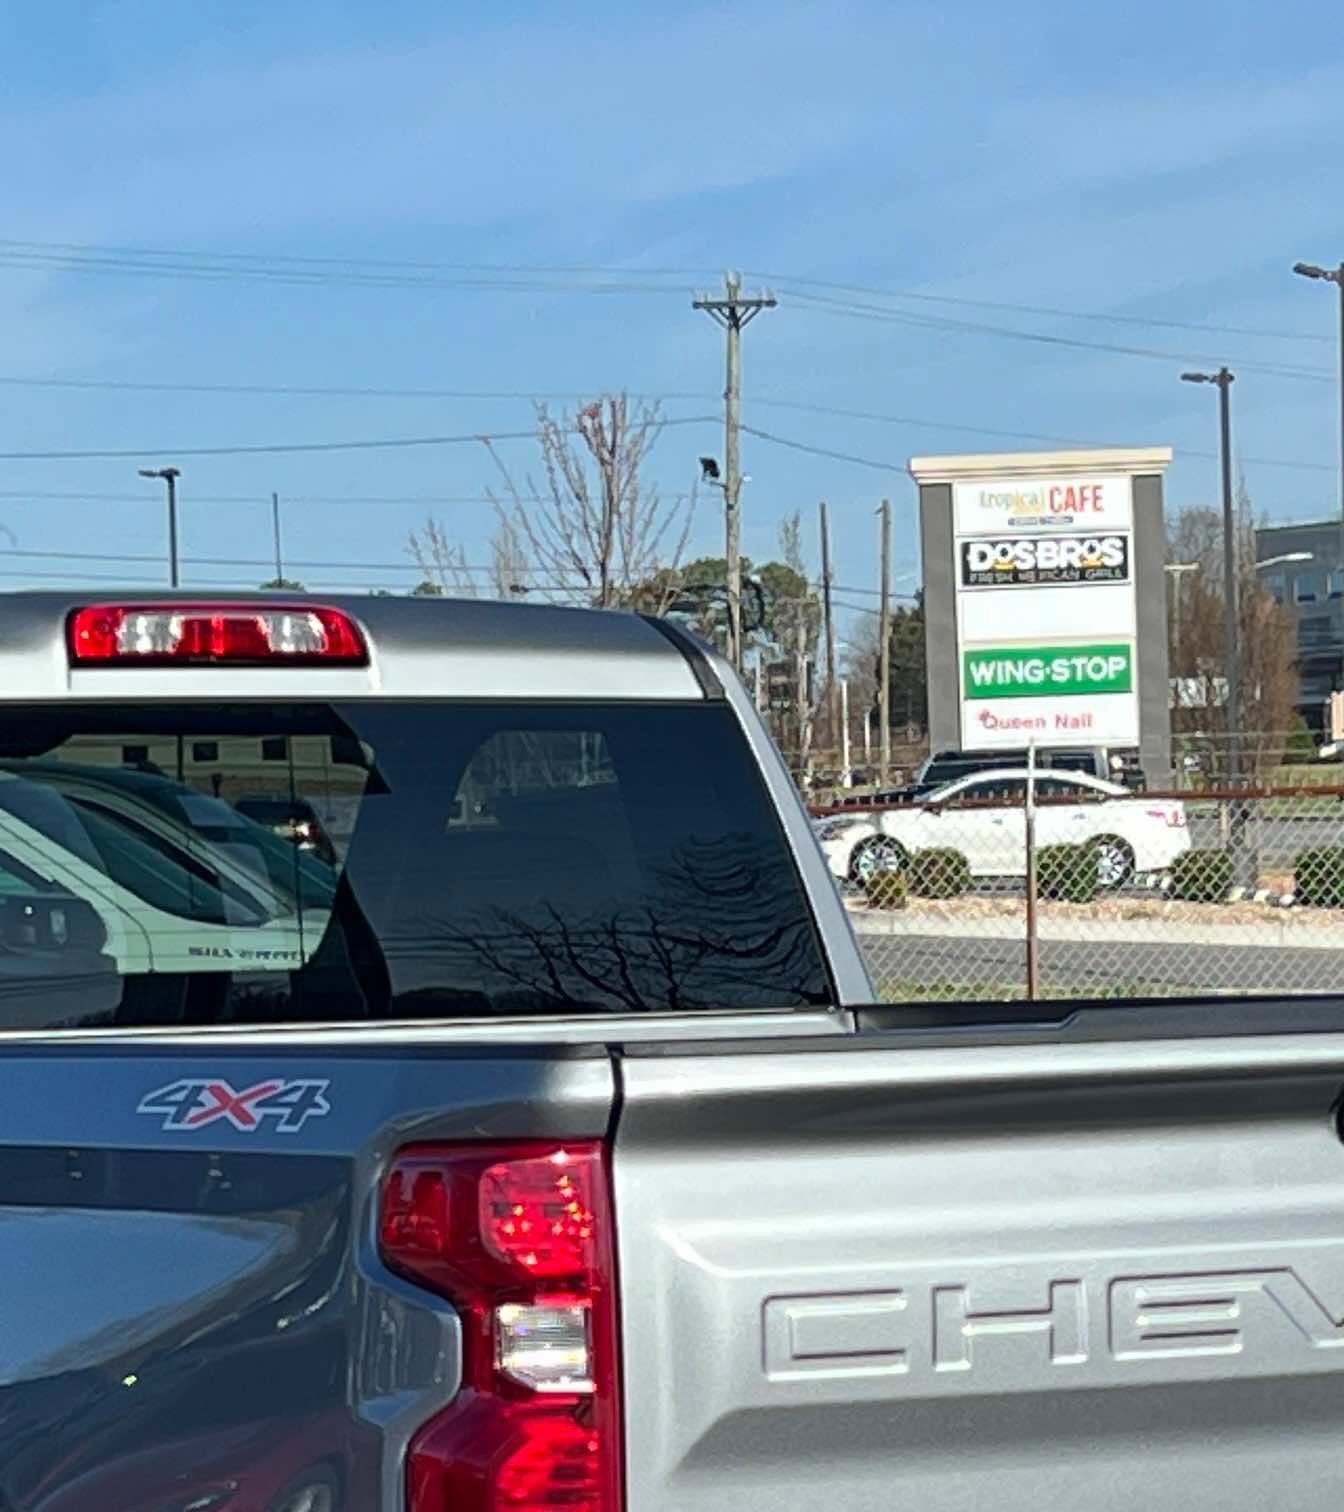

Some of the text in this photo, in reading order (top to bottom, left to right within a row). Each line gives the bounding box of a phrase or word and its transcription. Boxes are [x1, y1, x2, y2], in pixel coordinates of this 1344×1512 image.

[1049, 485, 1104, 513] CAFE
[980, 712, 1093, 731] Queen Nail
